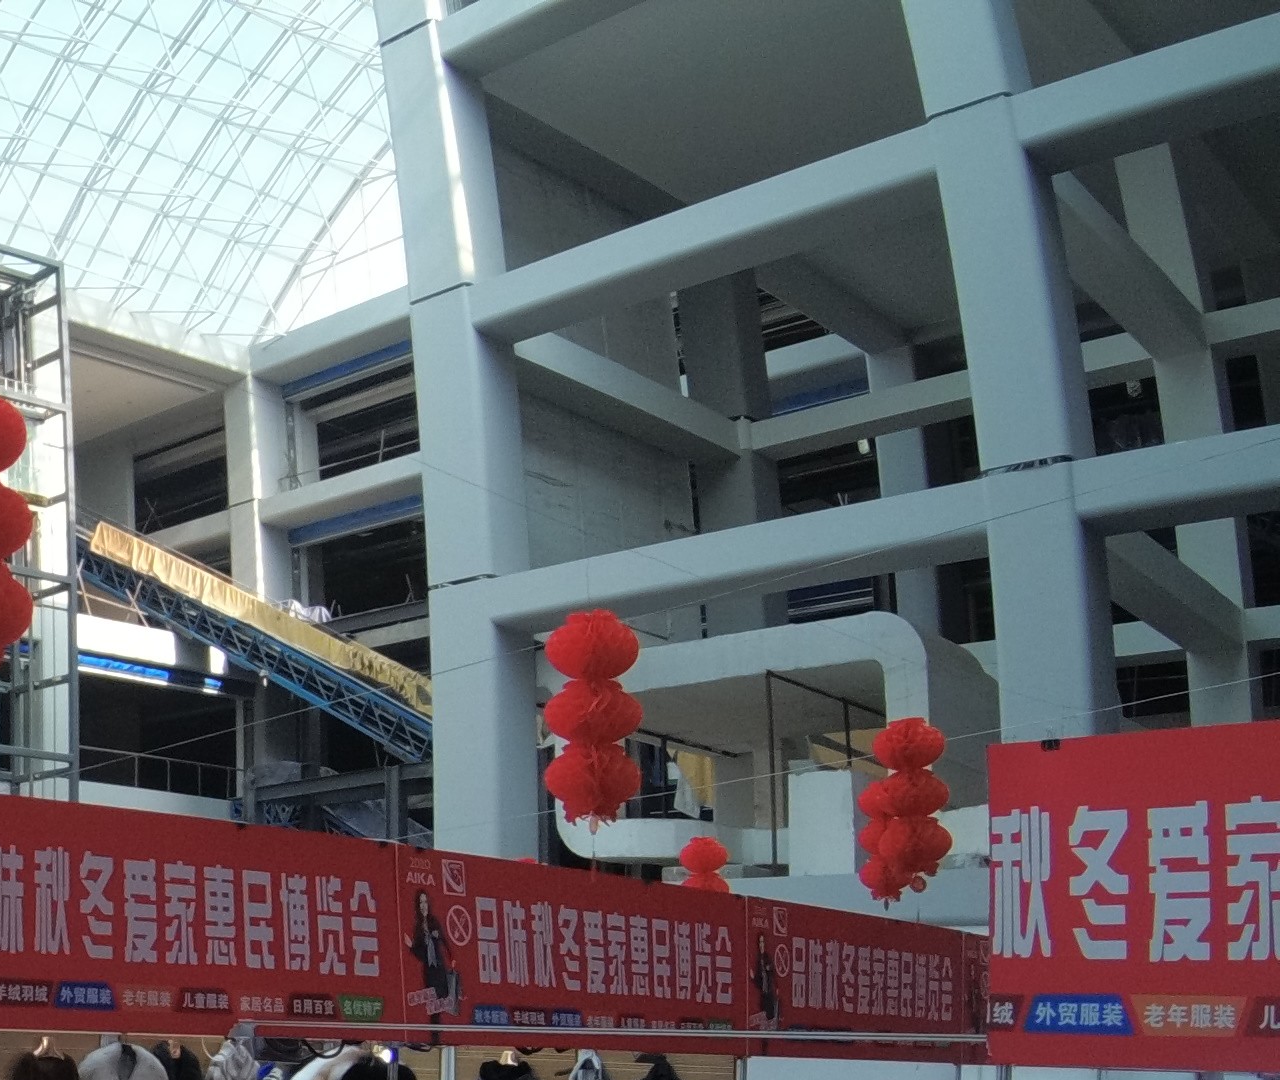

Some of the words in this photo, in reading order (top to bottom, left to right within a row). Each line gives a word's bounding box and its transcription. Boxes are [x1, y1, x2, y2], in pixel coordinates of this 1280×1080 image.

[405, 871, 436, 887] AIKA
[991, 795, 1280, 962] 秋冬爱家
[475, 896, 733, 1006] 品味秋冬爱家惠民博览会
[791, 936, 953, 1022] 品味秋冬爱家惠民博览会
[59, 986, 112, 1005] 外贸服装
[122, 989, 172, 1008] 老年服装
[182, 992, 230, 1010] 儿童服装
[239, 995, 285, 1013] 家居名品
[293, 998, 335, 1016] 日用百货
[1035, 1002, 1124, 1028] 外贸服装
[1144, 1003, 1237, 1029] 老年服装
